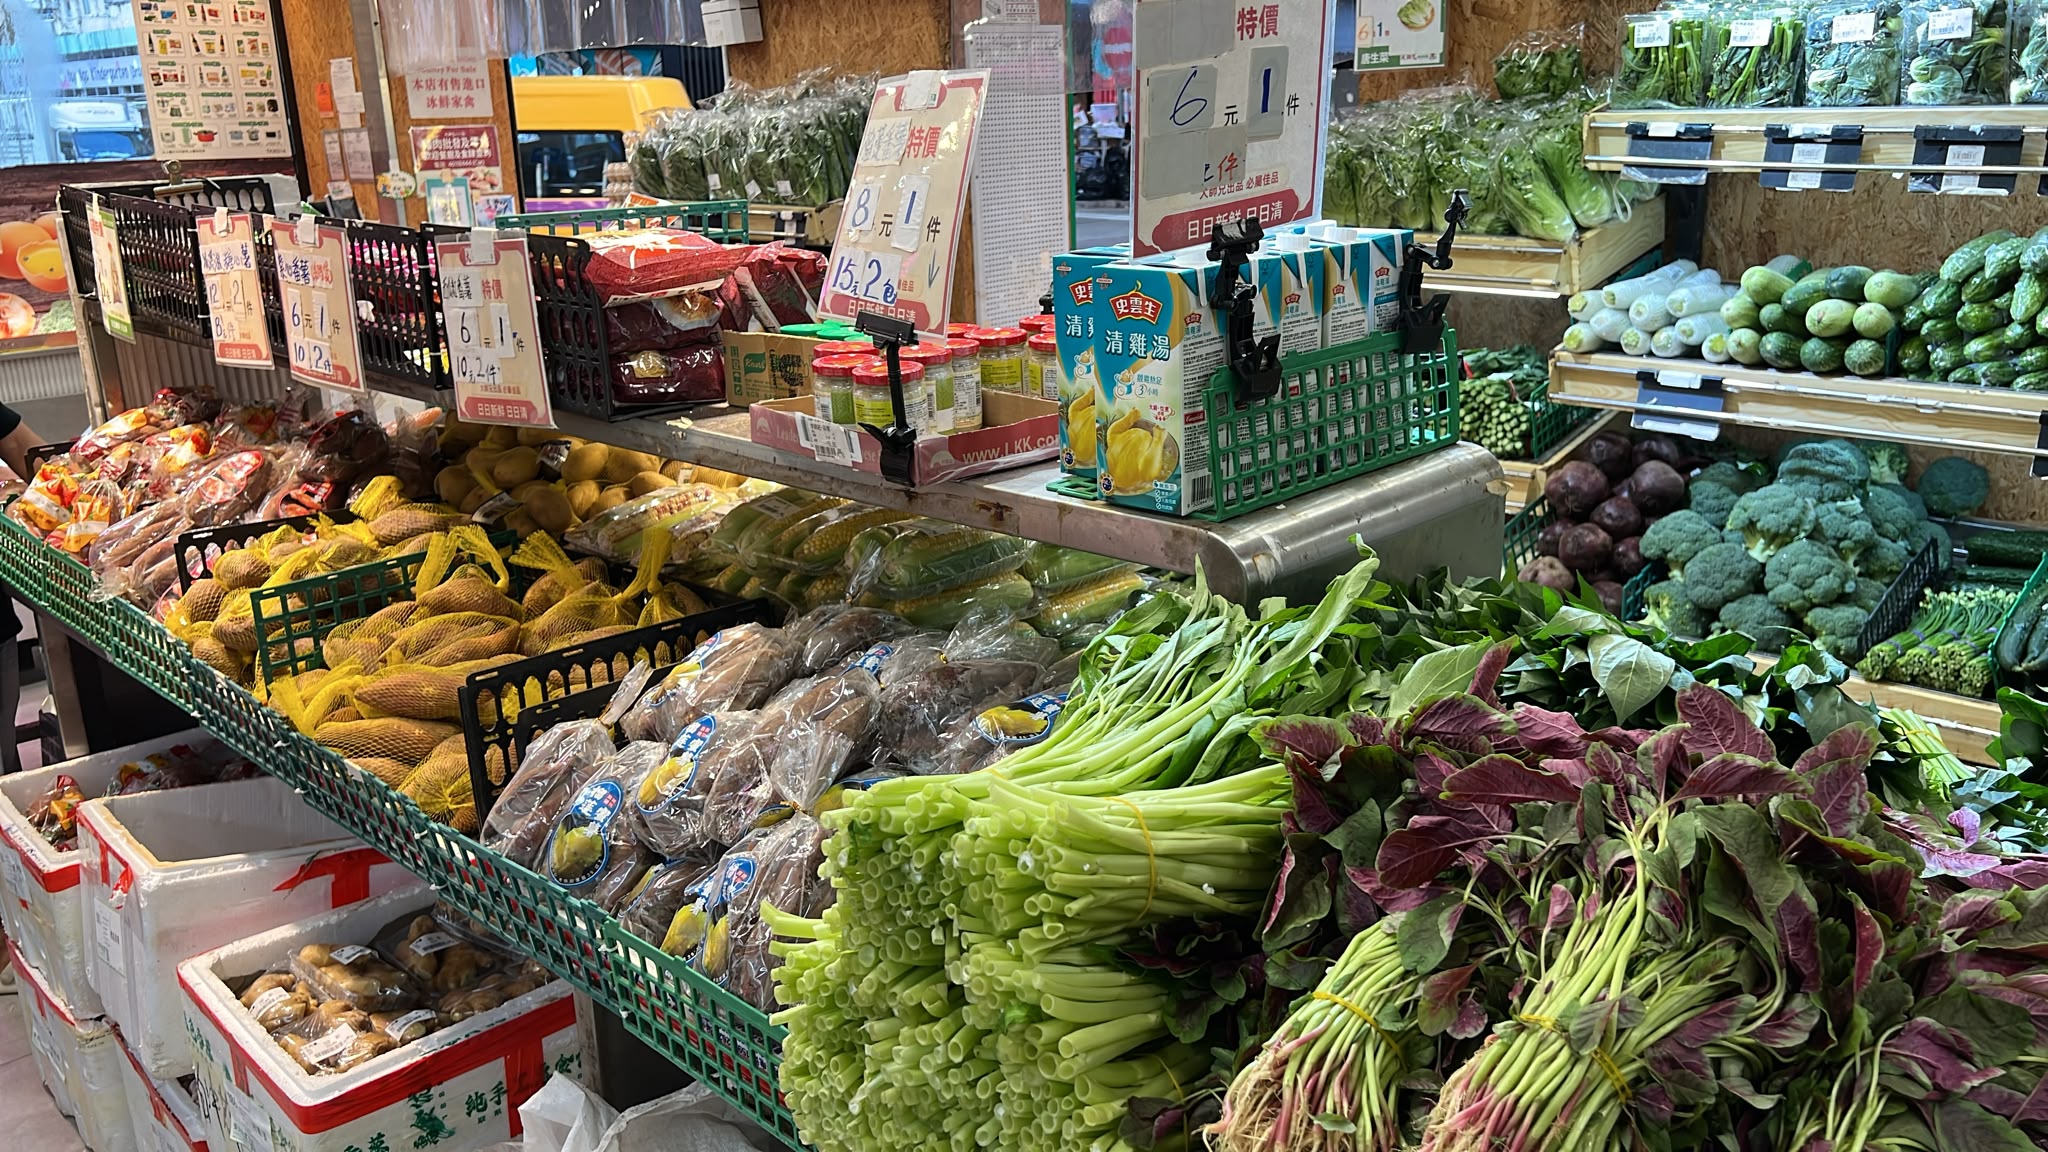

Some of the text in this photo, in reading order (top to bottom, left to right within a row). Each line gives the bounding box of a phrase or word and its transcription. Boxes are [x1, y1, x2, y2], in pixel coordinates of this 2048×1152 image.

[1236, 4, 1280, 41] 特價
[1358, 22, 1382, 40] 6 1
[413, 77, 485, 92] 本店有售進口
[1169, 65, 1300, 127] 6 元 1 件
[907, 126, 942, 159] 特價
[1246, 171, 1279, 189] 必屬佳品
[852, 188, 942, 243] 8 元 1 件
[209, 282, 220, 305] 12
[233, 279, 243, 305] 2
[481, 279, 504, 300] 特價
[291, 302, 300, 327] 6
[1115, 296, 1156, 319] 史雲生
[460, 311, 471, 344] 6
[498, 316, 505, 347] 1
[515, 337, 525, 353] 件
[293, 341, 306, 364] 10
[1105, 329, 1172, 361] 清雞湯
